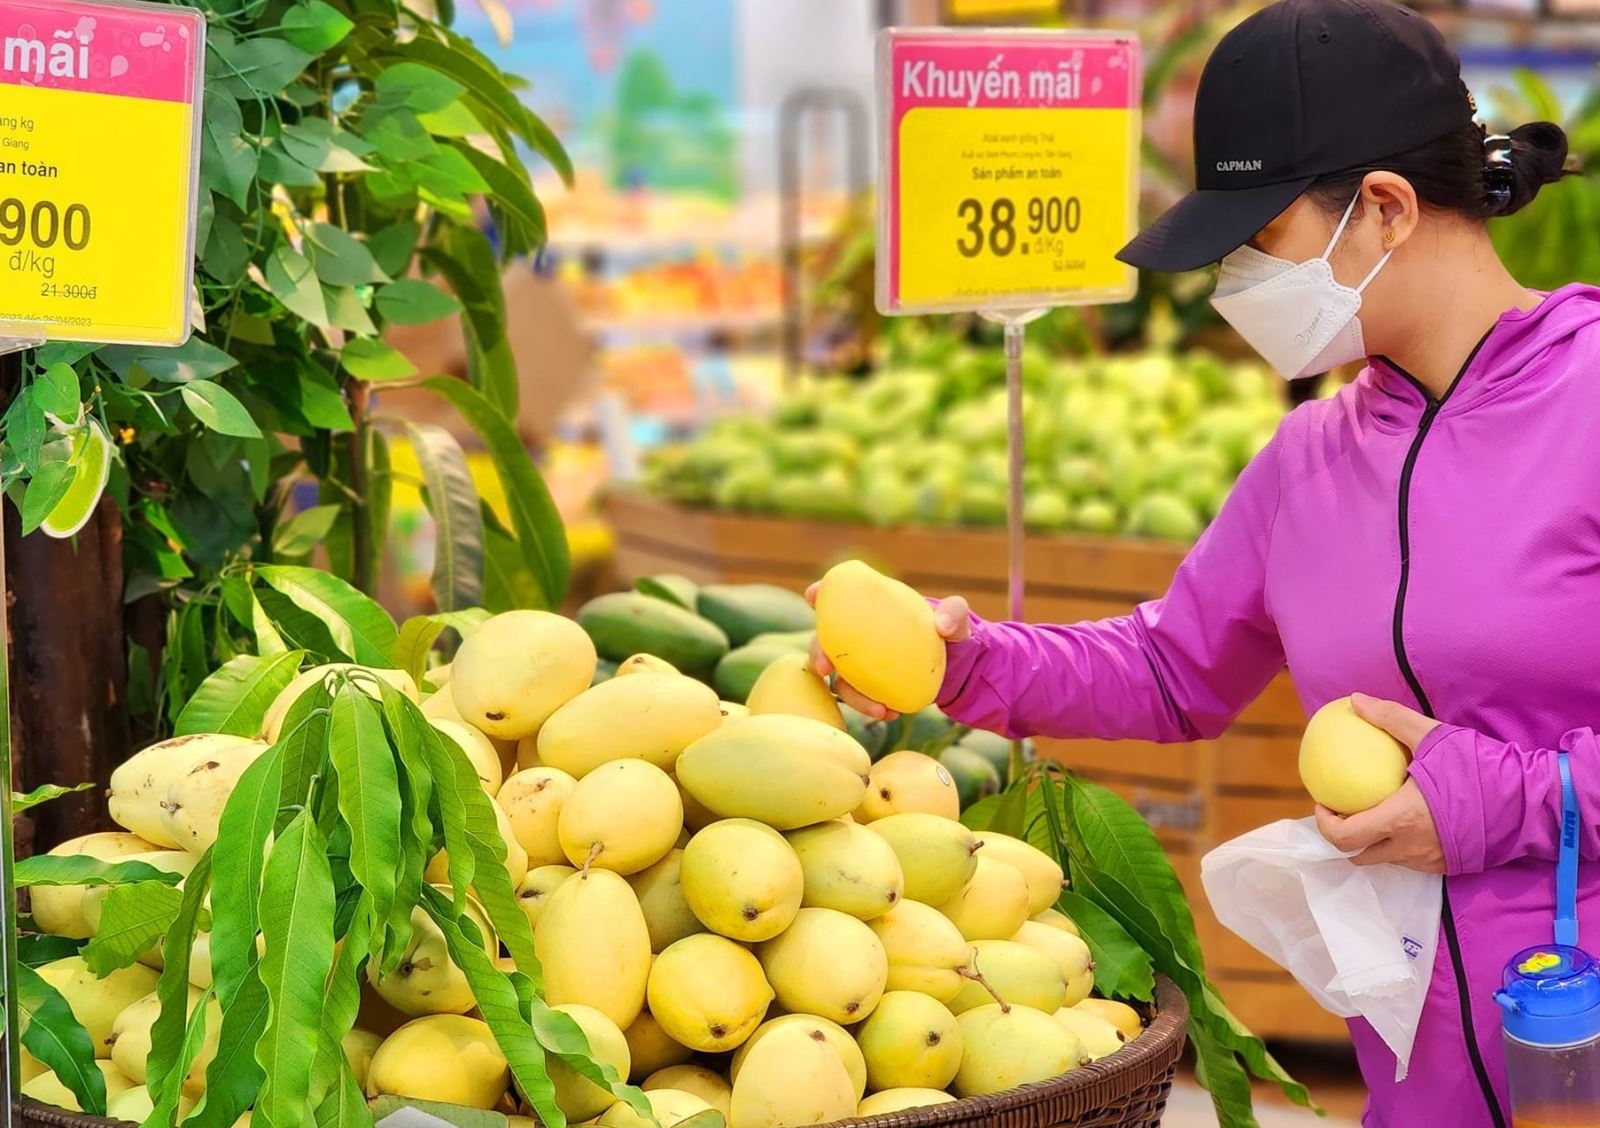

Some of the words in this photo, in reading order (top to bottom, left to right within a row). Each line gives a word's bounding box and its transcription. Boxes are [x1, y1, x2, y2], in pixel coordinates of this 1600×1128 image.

[4, 28, 90, 80] mãi
[902, 54, 1020, 107] Khuyến
[1028, 61, 1080, 99] mãi
[21, 116, 34, 132] kg
[2, 137, 30, 151] Giang
[22, 160, 58, 178] toàn
[1216, 160, 1262, 172] CAPMAN
[0, 197, 91, 251] 900
[9, 250, 55, 278] đ/kg
[41, 283, 97, 300] 21.300đ
